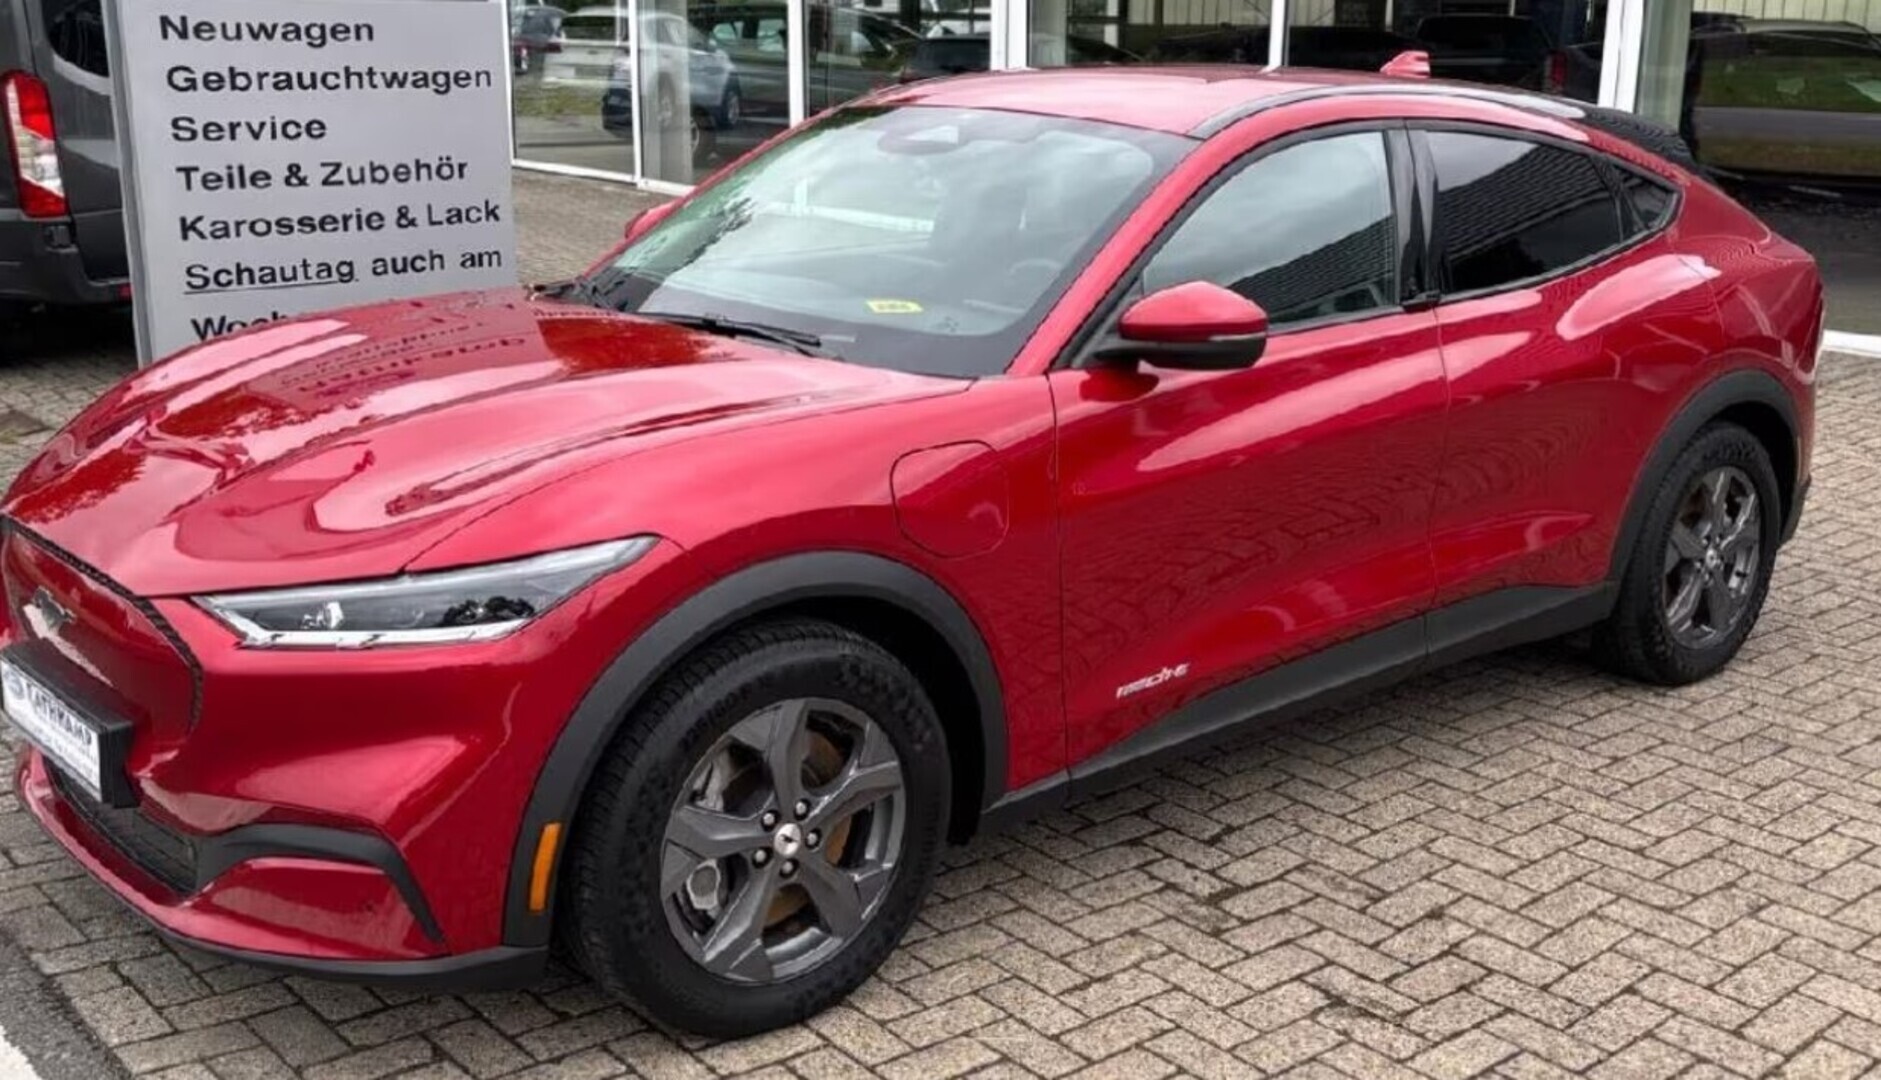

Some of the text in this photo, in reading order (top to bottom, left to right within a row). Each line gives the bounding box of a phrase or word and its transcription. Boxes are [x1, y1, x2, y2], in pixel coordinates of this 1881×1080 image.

[159, 15, 374, 48] Neuwagen
[166, 65, 492, 95] Gebrauchtwagen
[171, 115, 327, 142] Service
[175, 155, 468, 192] Teile & Zubehör
[179, 199, 501, 241] Karosserie & Lack
[185, 249, 502, 291] Schautag auch am
